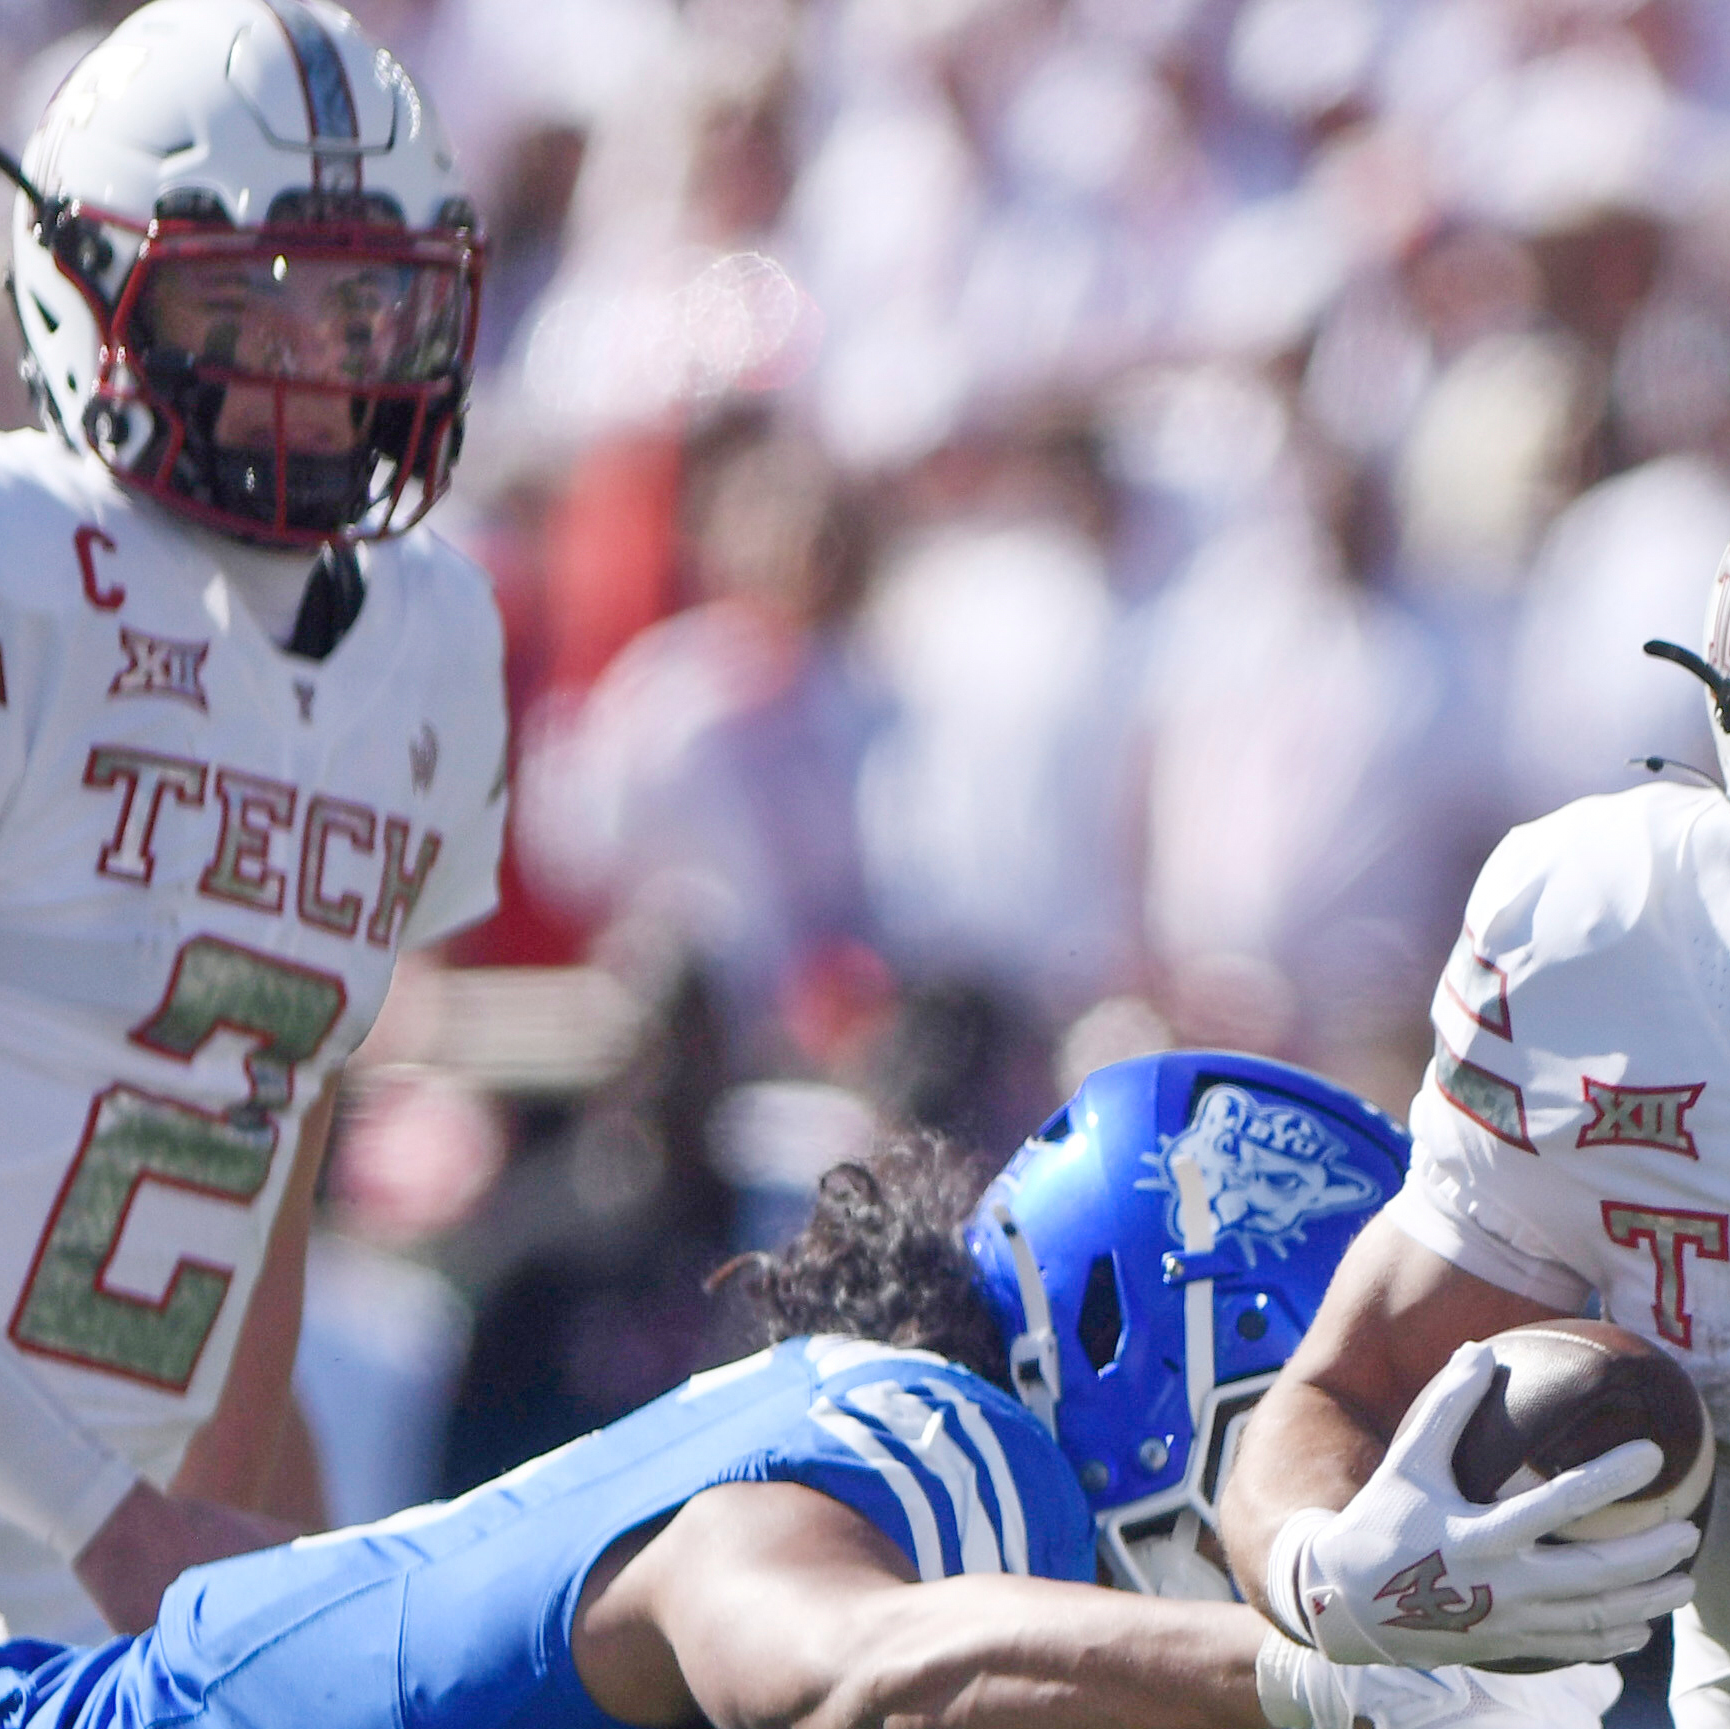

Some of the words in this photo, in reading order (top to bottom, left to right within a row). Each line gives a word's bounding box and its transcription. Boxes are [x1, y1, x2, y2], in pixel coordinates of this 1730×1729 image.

[74, 525, 125, 611] C
[82, 745, 441, 948] TECH
[8, 934, 348, 1397] 2
